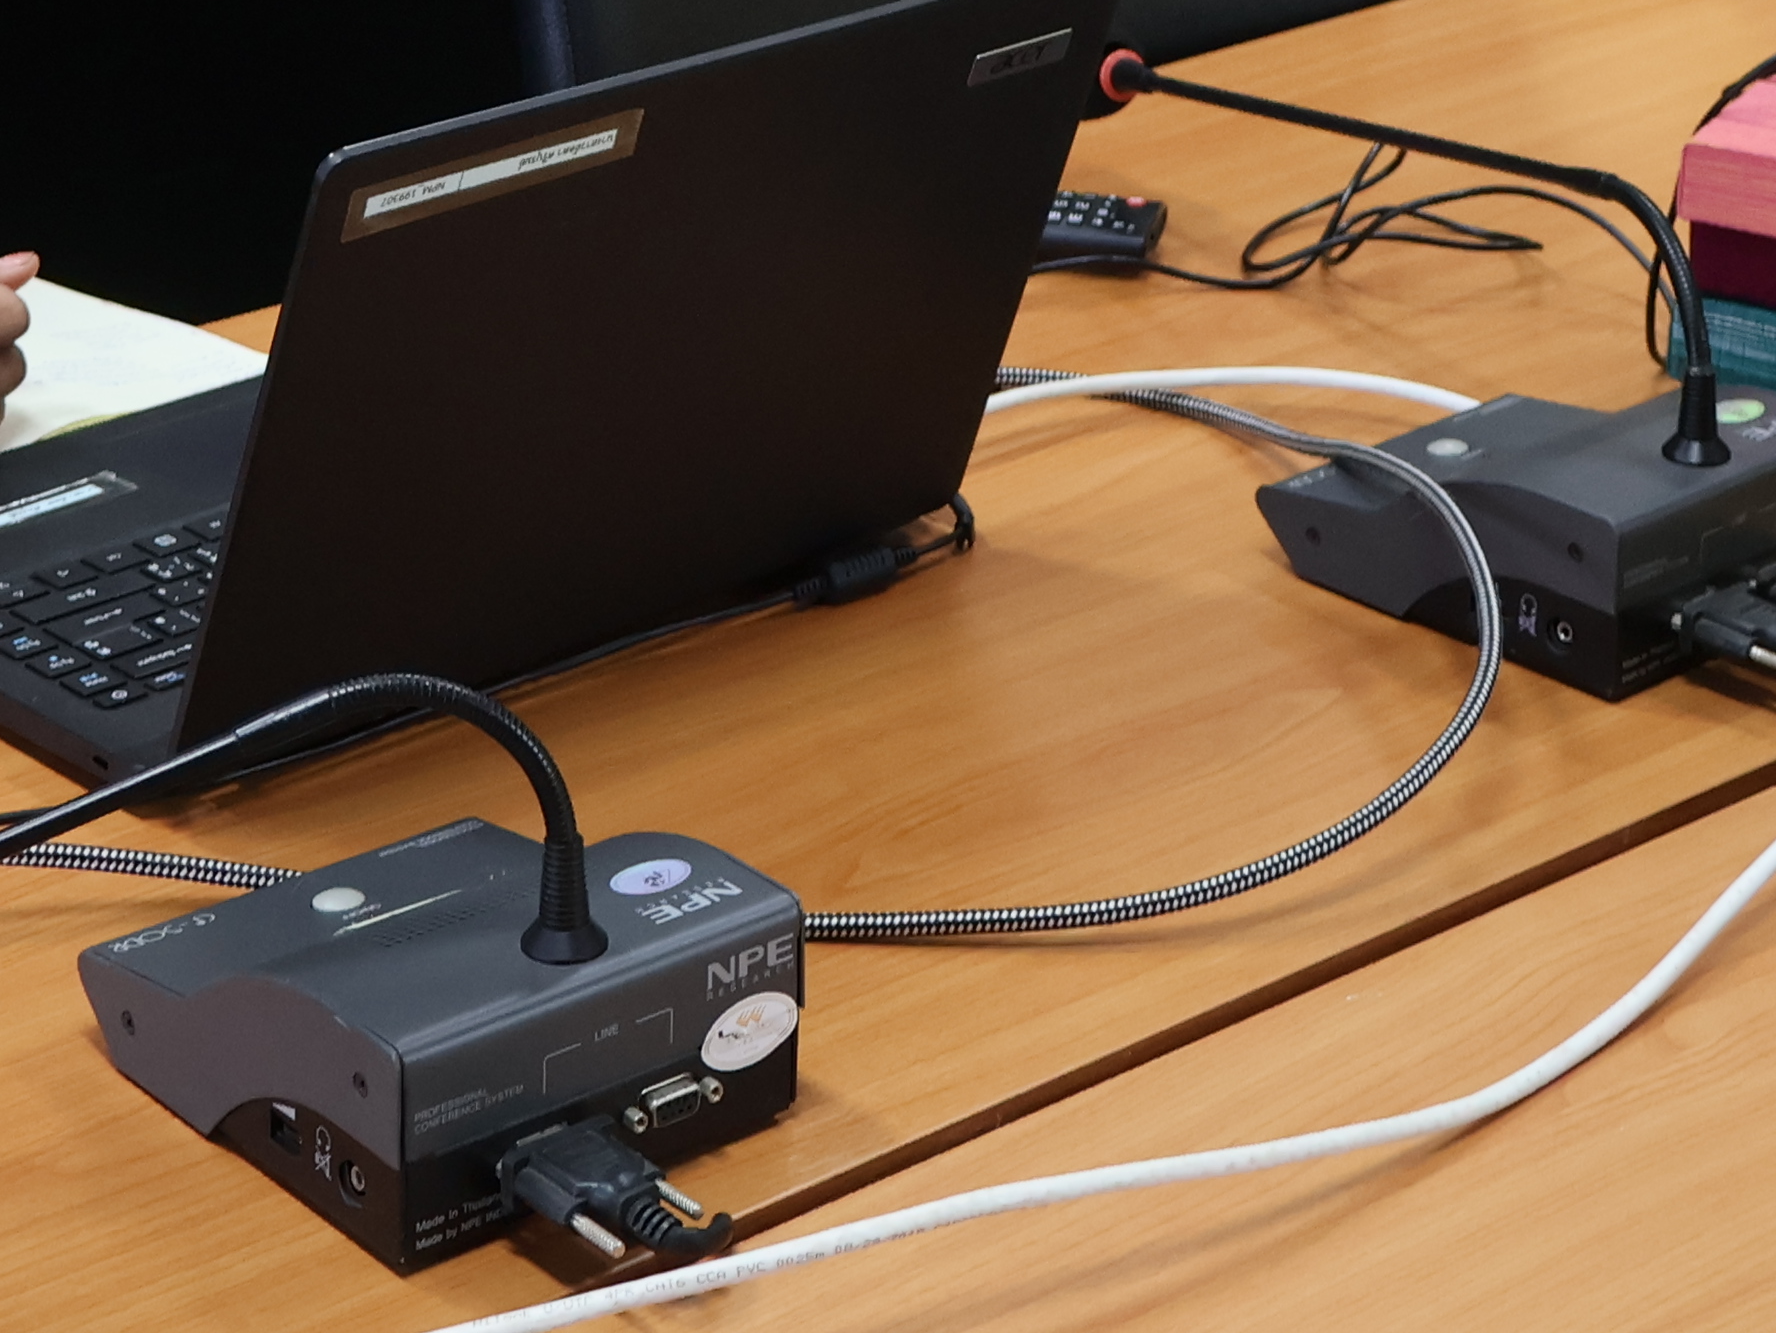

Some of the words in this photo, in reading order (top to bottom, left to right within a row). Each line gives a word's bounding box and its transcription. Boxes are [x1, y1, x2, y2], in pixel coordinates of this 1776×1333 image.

[641, 880, 744, 925] NPE
[707, 931, 795, 989] NPE
[594, 1022, 620, 1042] LINE
[413, 1087, 488, 1123] PROFESSIONAL
[413, 1101, 481, 1134] CONFERENCE
[484, 1084, 525, 1107] SYSTEM
[415, 1214, 446, 1234] Made
[415, 1233, 444, 1251] Made
[445, 1227, 458, 1240] by
[460, 1215, 482, 1232] NPE
